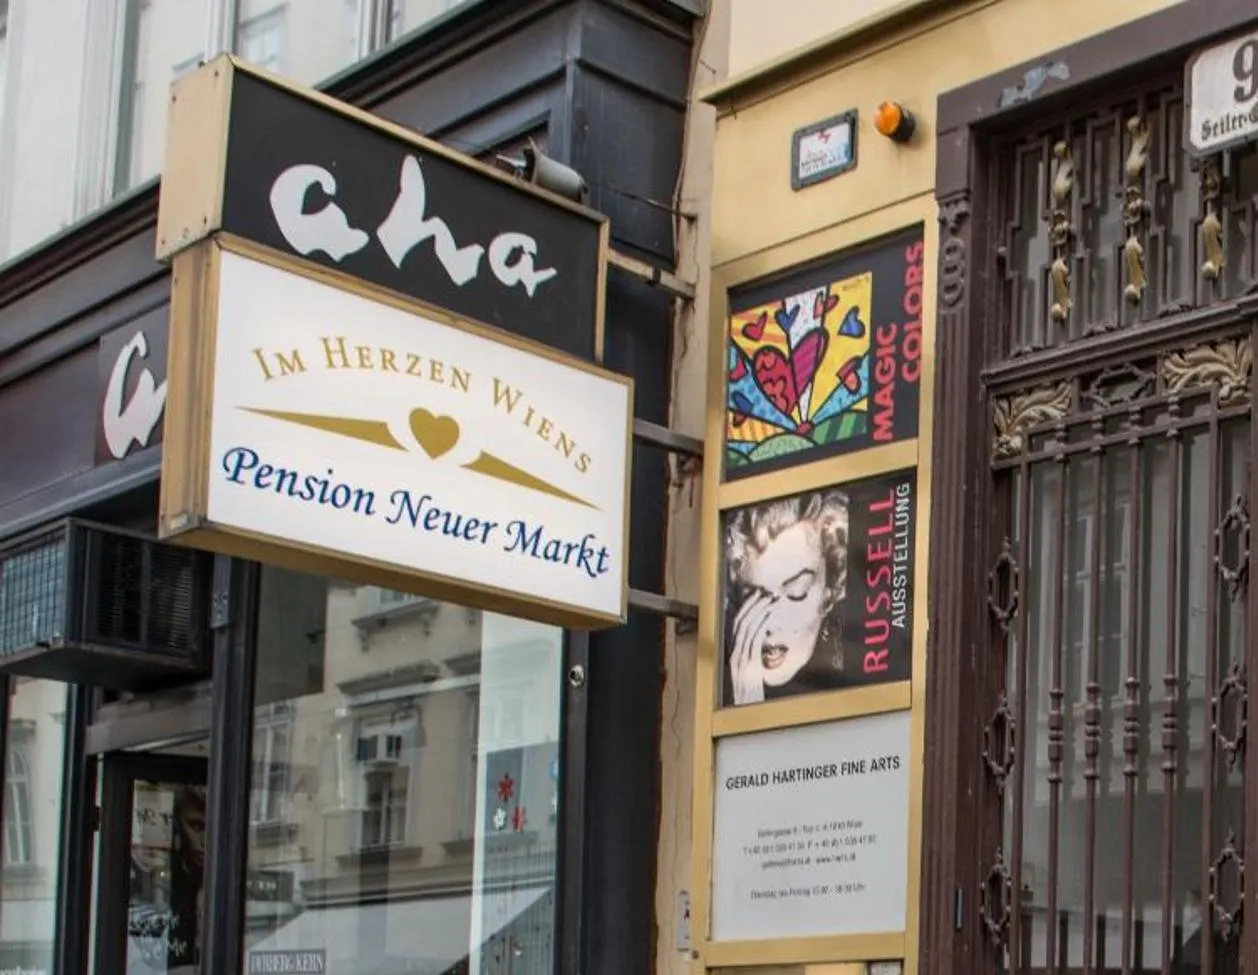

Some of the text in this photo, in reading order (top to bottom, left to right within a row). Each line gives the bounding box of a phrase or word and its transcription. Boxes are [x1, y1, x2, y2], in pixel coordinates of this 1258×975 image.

[902, 241, 923, 382] COLORS
[873, 321, 898, 441] MAGIC
[222, 447, 612, 579] Pension Neuer Markt
[863, 487, 896, 674] RUSSELL
[891, 482, 910, 628] AUSSTELLUNG
[725, 755, 901, 790] GERALD HARTINGER FINE ARTS
